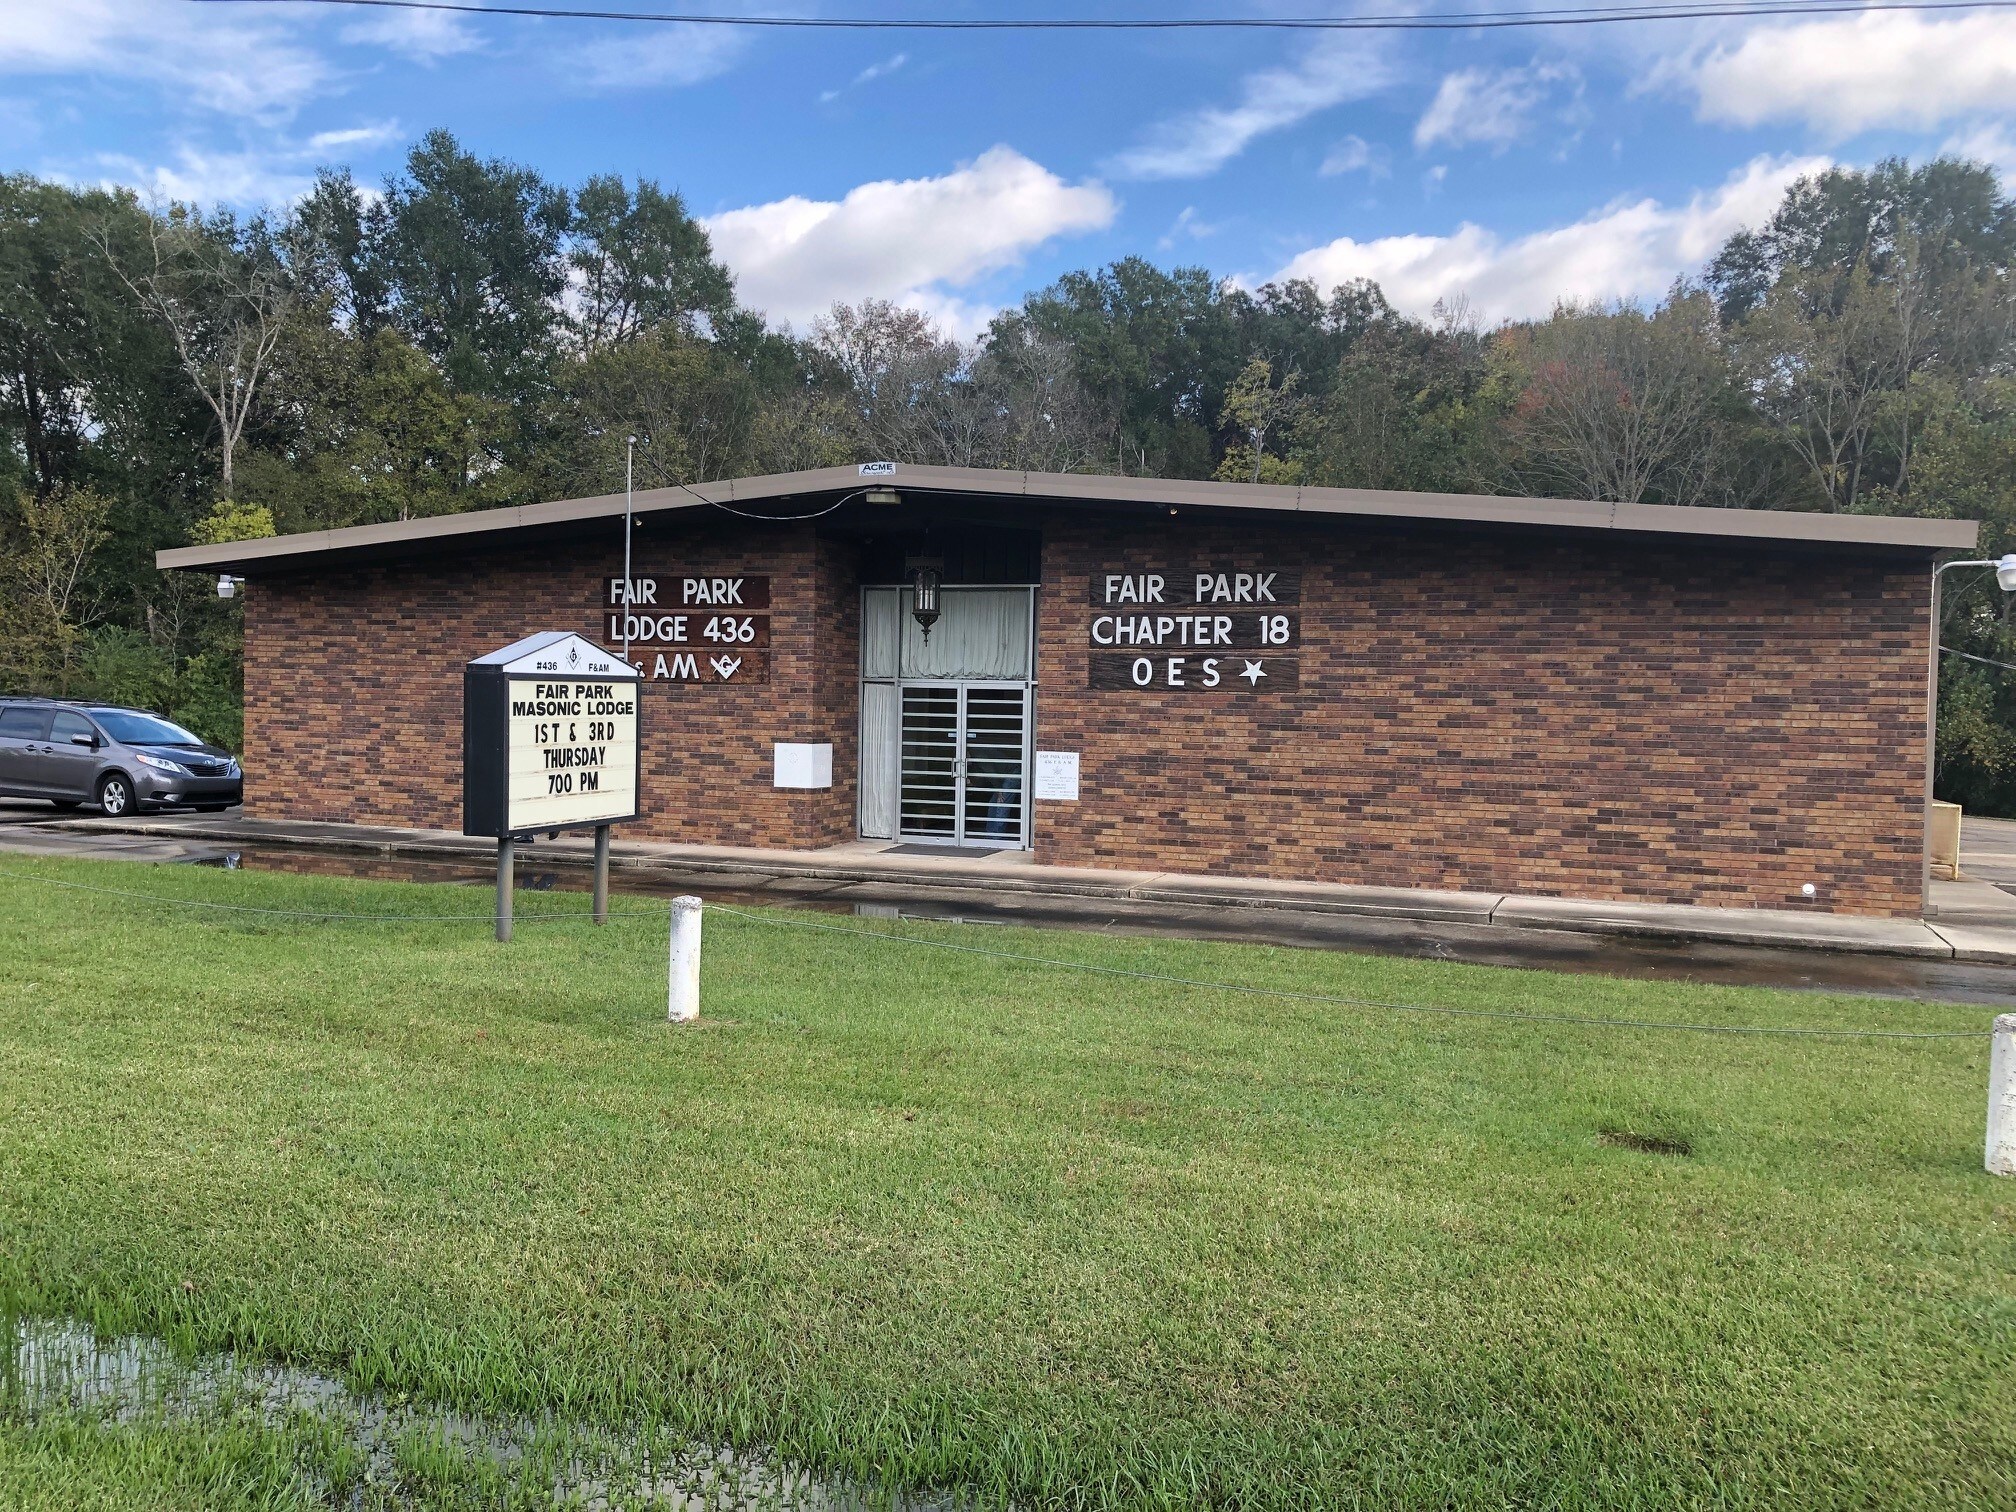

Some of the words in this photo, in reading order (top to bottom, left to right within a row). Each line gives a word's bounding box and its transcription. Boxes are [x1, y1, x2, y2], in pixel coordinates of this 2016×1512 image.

[863, 463, 893, 471] ACME
[610, 578, 658, 604] FAIR
[683, 578, 745, 605] PARK
[1105, 574, 1165, 603] FAIR
[1195, 572, 1278, 602] PARK
[611, 615, 688, 642] LODGE
[703, 616, 755, 643] 436
[1092, 615, 1233, 645] CHAPTER
[1258, 615, 1290, 645] 18
[536, 661, 558, 671] #436
[588, 662, 610, 673] F&AM
[653, 653, 700, 679] AM
[535, 684, 570, 699] FAIR
[575, 685, 613, 699] PARK
[512, 701, 581, 717] MASONIC
[587, 701, 634, 715] LODGE
[534, 723, 560, 743] 1ST
[569, 723, 577, 742] &
[589, 721, 615, 741] 3RD
[543, 746, 606, 769] THURSDAY
[548, 773, 572, 795] 700
[580, 771, 599, 791] PM
